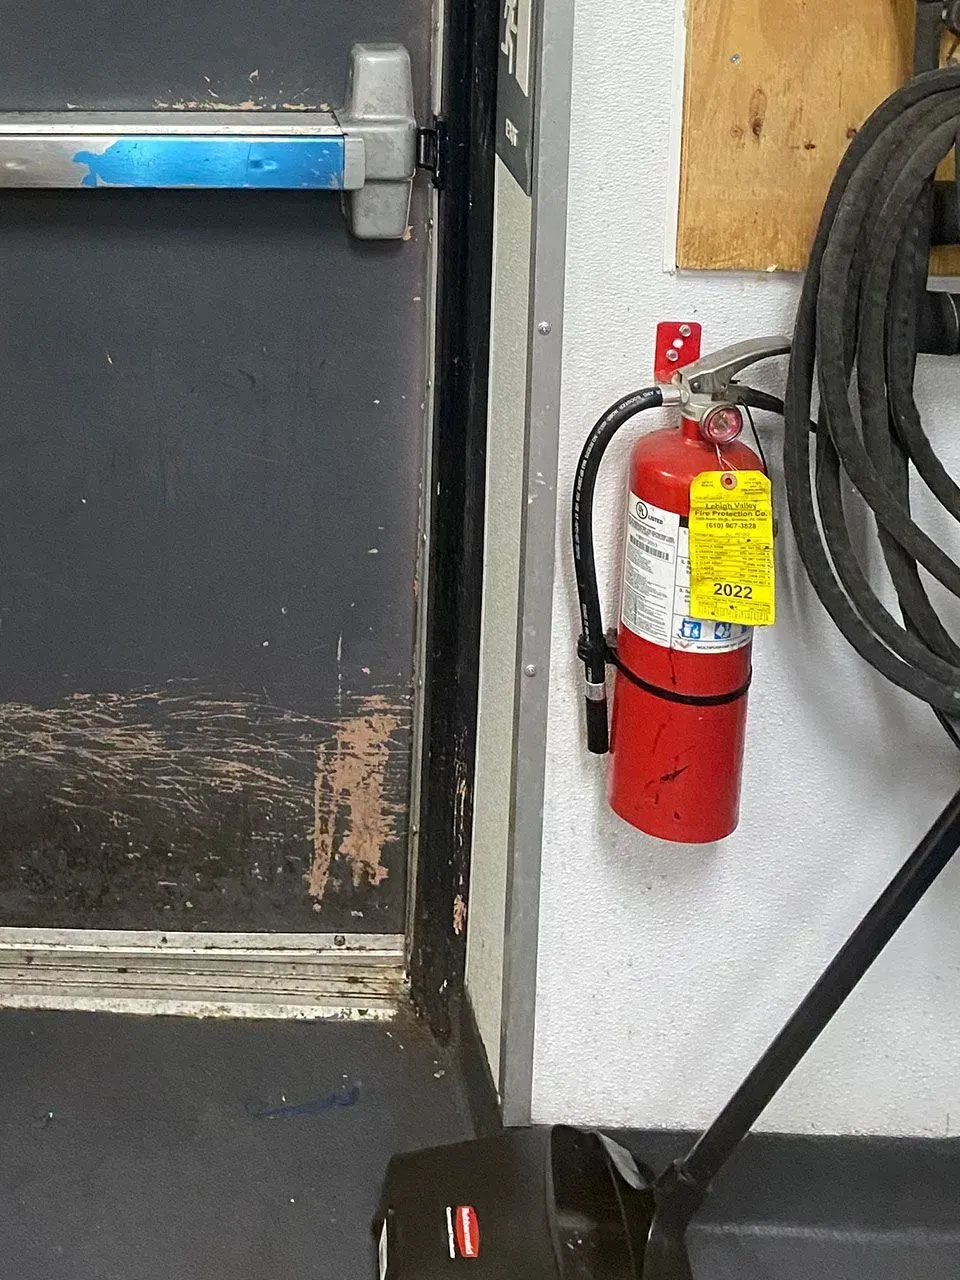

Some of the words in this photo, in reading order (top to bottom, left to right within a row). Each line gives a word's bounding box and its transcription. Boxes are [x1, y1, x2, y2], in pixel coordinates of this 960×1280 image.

[705, 503, 733, 511] Lehigh
[734, 502, 758, 510] Valley
[754, 509, 768, 517] Co.
[713, 582, 753, 600] 2022
